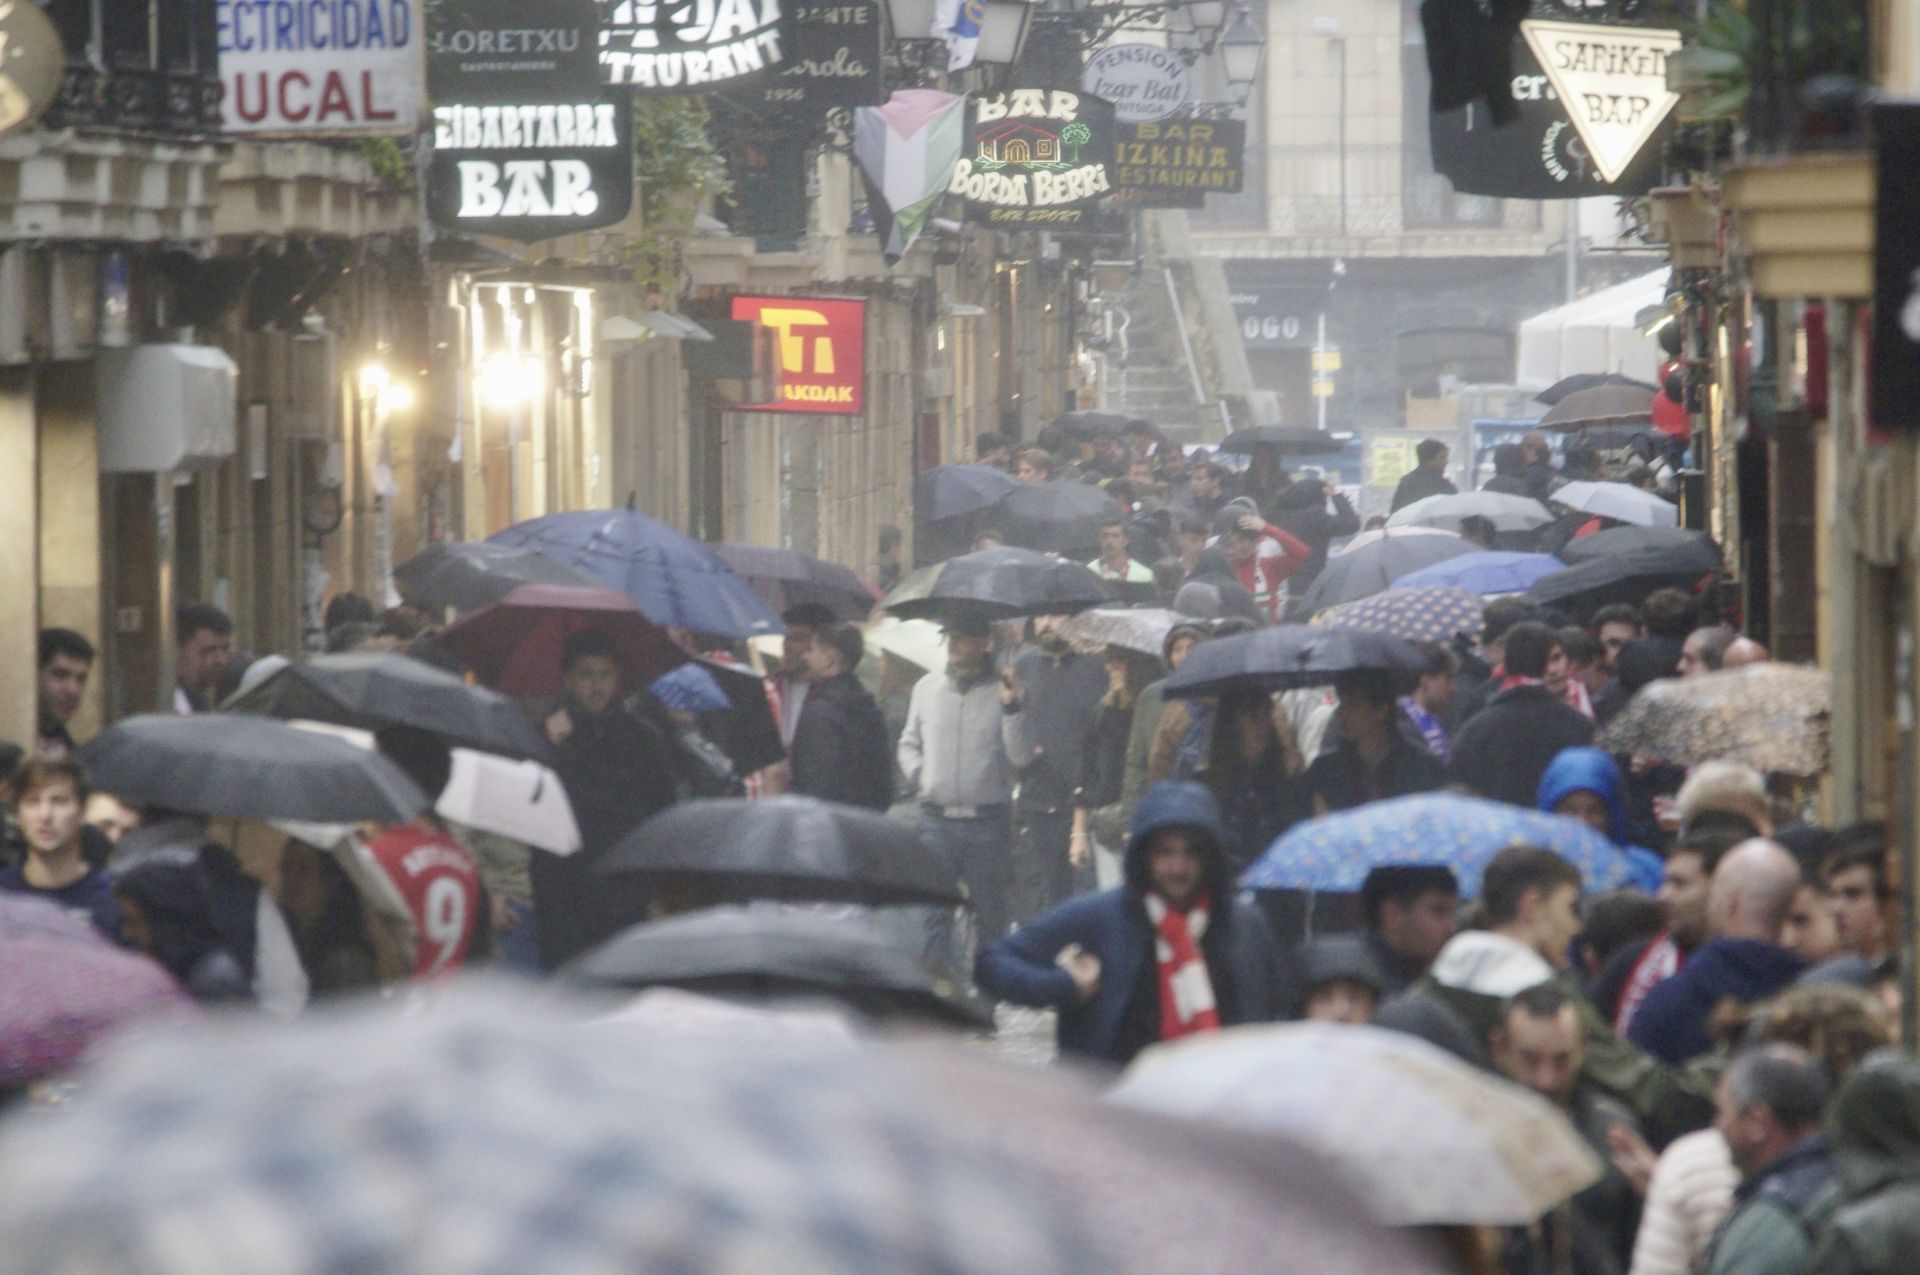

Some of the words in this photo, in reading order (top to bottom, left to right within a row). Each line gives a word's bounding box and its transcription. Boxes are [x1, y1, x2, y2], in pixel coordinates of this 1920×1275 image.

[434, 29, 581, 54] LORETXU
[217, 70, 397, 124] UCAL
[1093, 77, 1140, 99] Izar
[976, 88, 1079, 123] BAR
[1583, 93, 1650, 125] BAR
[1136, 122, 1215, 142] BAR
[456, 159, 599, 217] BAR
[948, 158, 1028, 206] BORDA
[989, 208, 1025, 223] BAR
[1024, 208, 1083, 224] SPORT
[423, 876, 467, 977] 9
